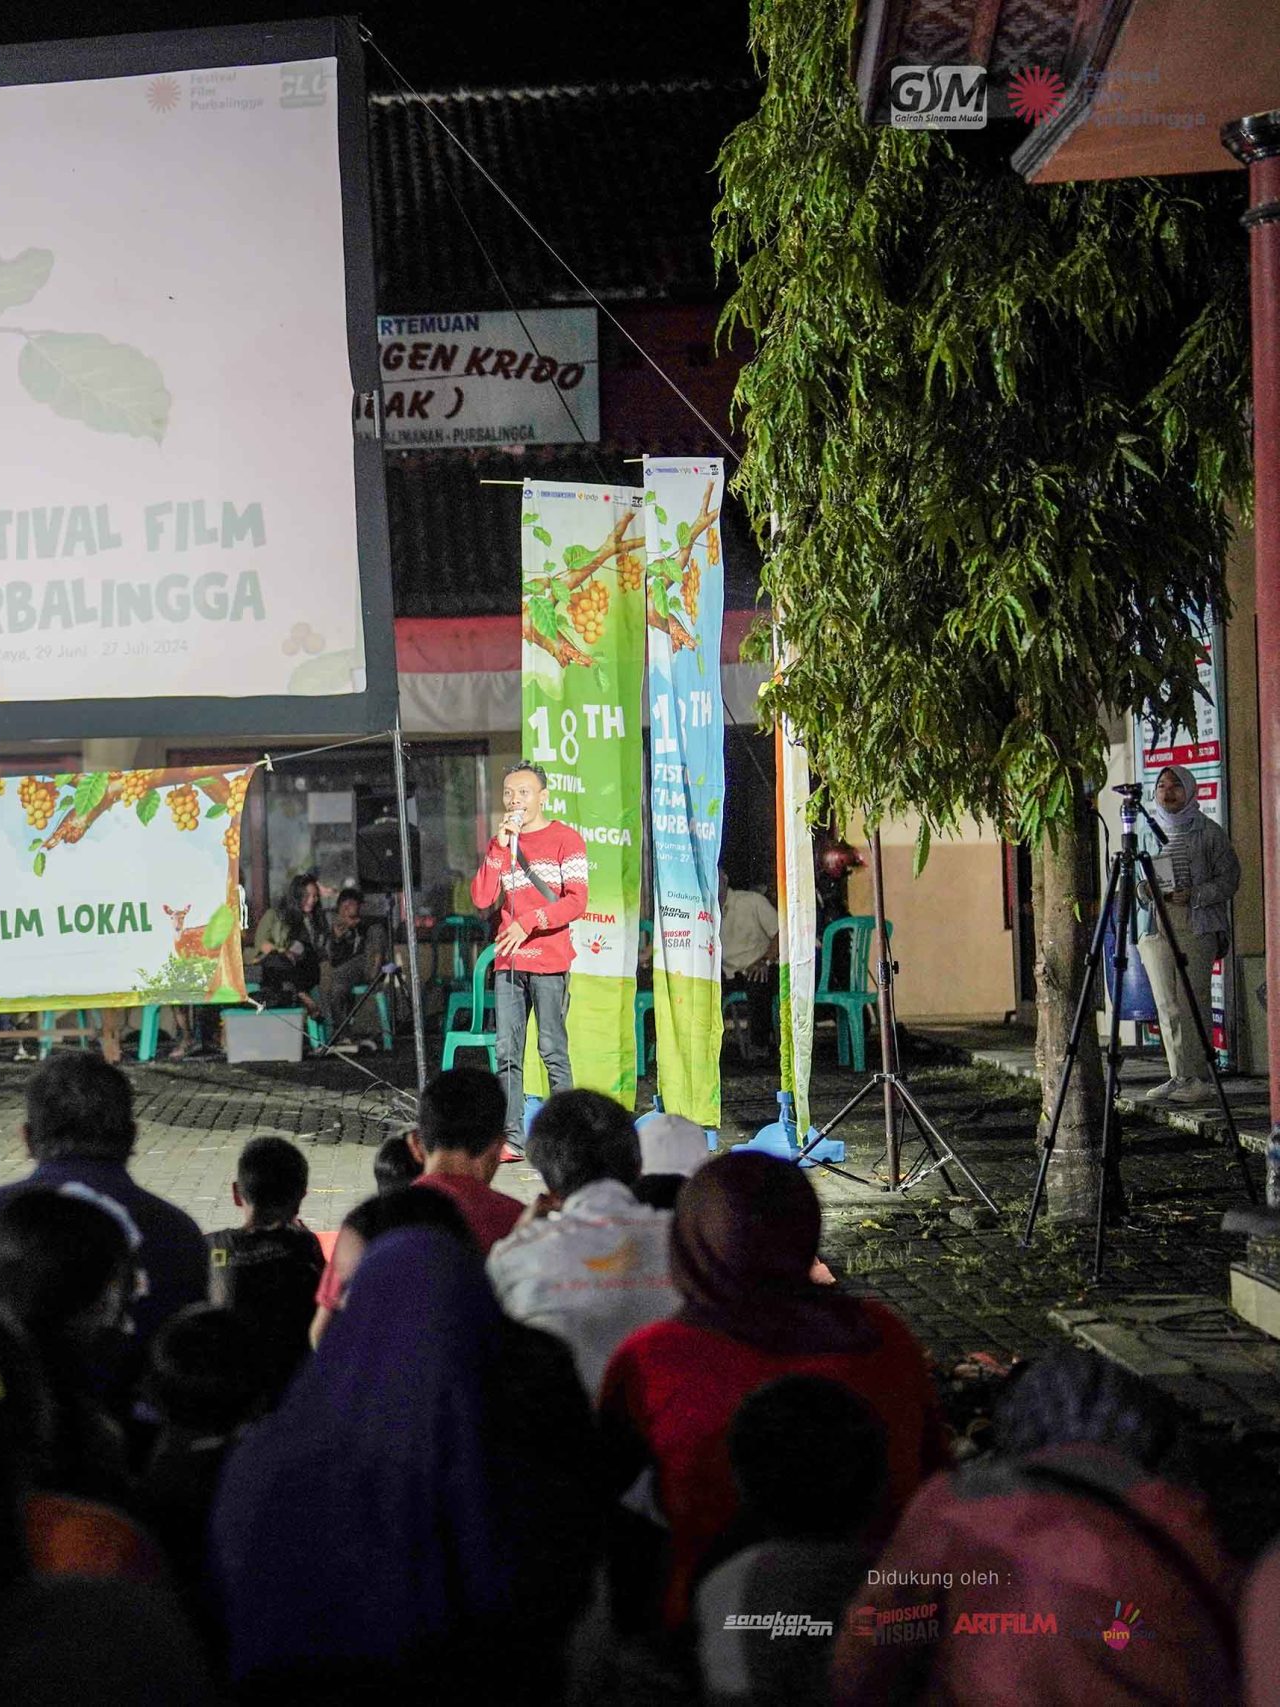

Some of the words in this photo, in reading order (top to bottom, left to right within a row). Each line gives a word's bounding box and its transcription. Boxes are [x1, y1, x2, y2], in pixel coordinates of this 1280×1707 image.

[381, 315, 480, 336] RTEMUAN
[381, 342, 460, 372] GEN
[144, 499, 267, 552] FILM
[528, 704, 625, 766] 18TH
[58, 902, 152, 935] LOKAL
[664, 938, 691, 948] ISBAR
